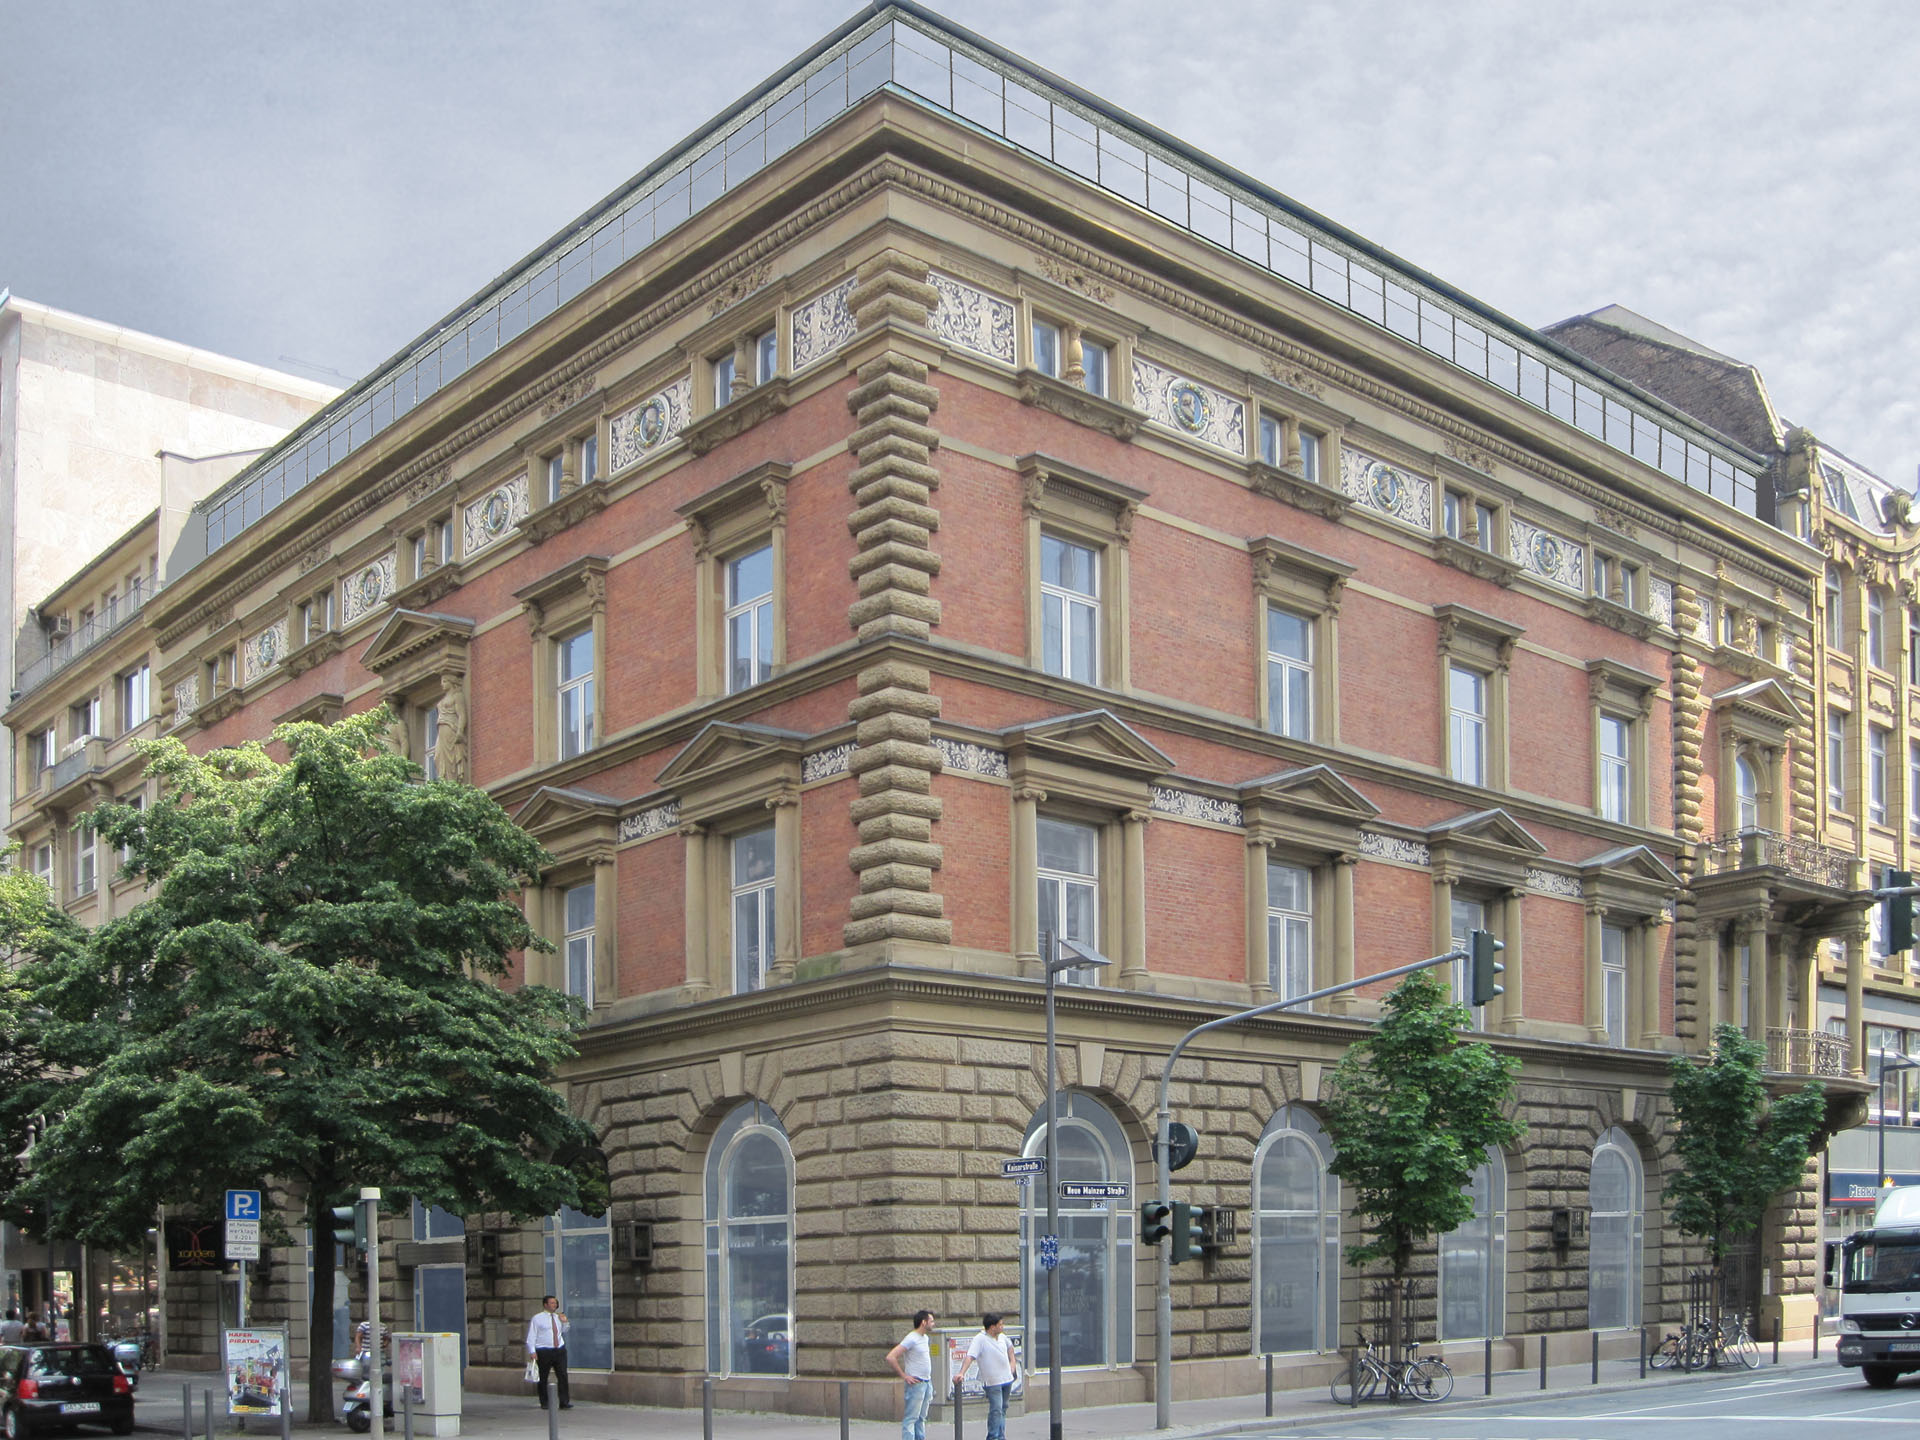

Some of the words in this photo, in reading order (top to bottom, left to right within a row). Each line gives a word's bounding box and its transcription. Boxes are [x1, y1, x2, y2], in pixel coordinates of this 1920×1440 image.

[1067, 1186, 1081, 1195] Neue
[1083, 1186, 1105, 1195] Mainzer
[1107, 1186, 1124, 1196] Straße
[1849, 1184, 1876, 1198] MERKU
[234, 1194, 253, 1216] P
